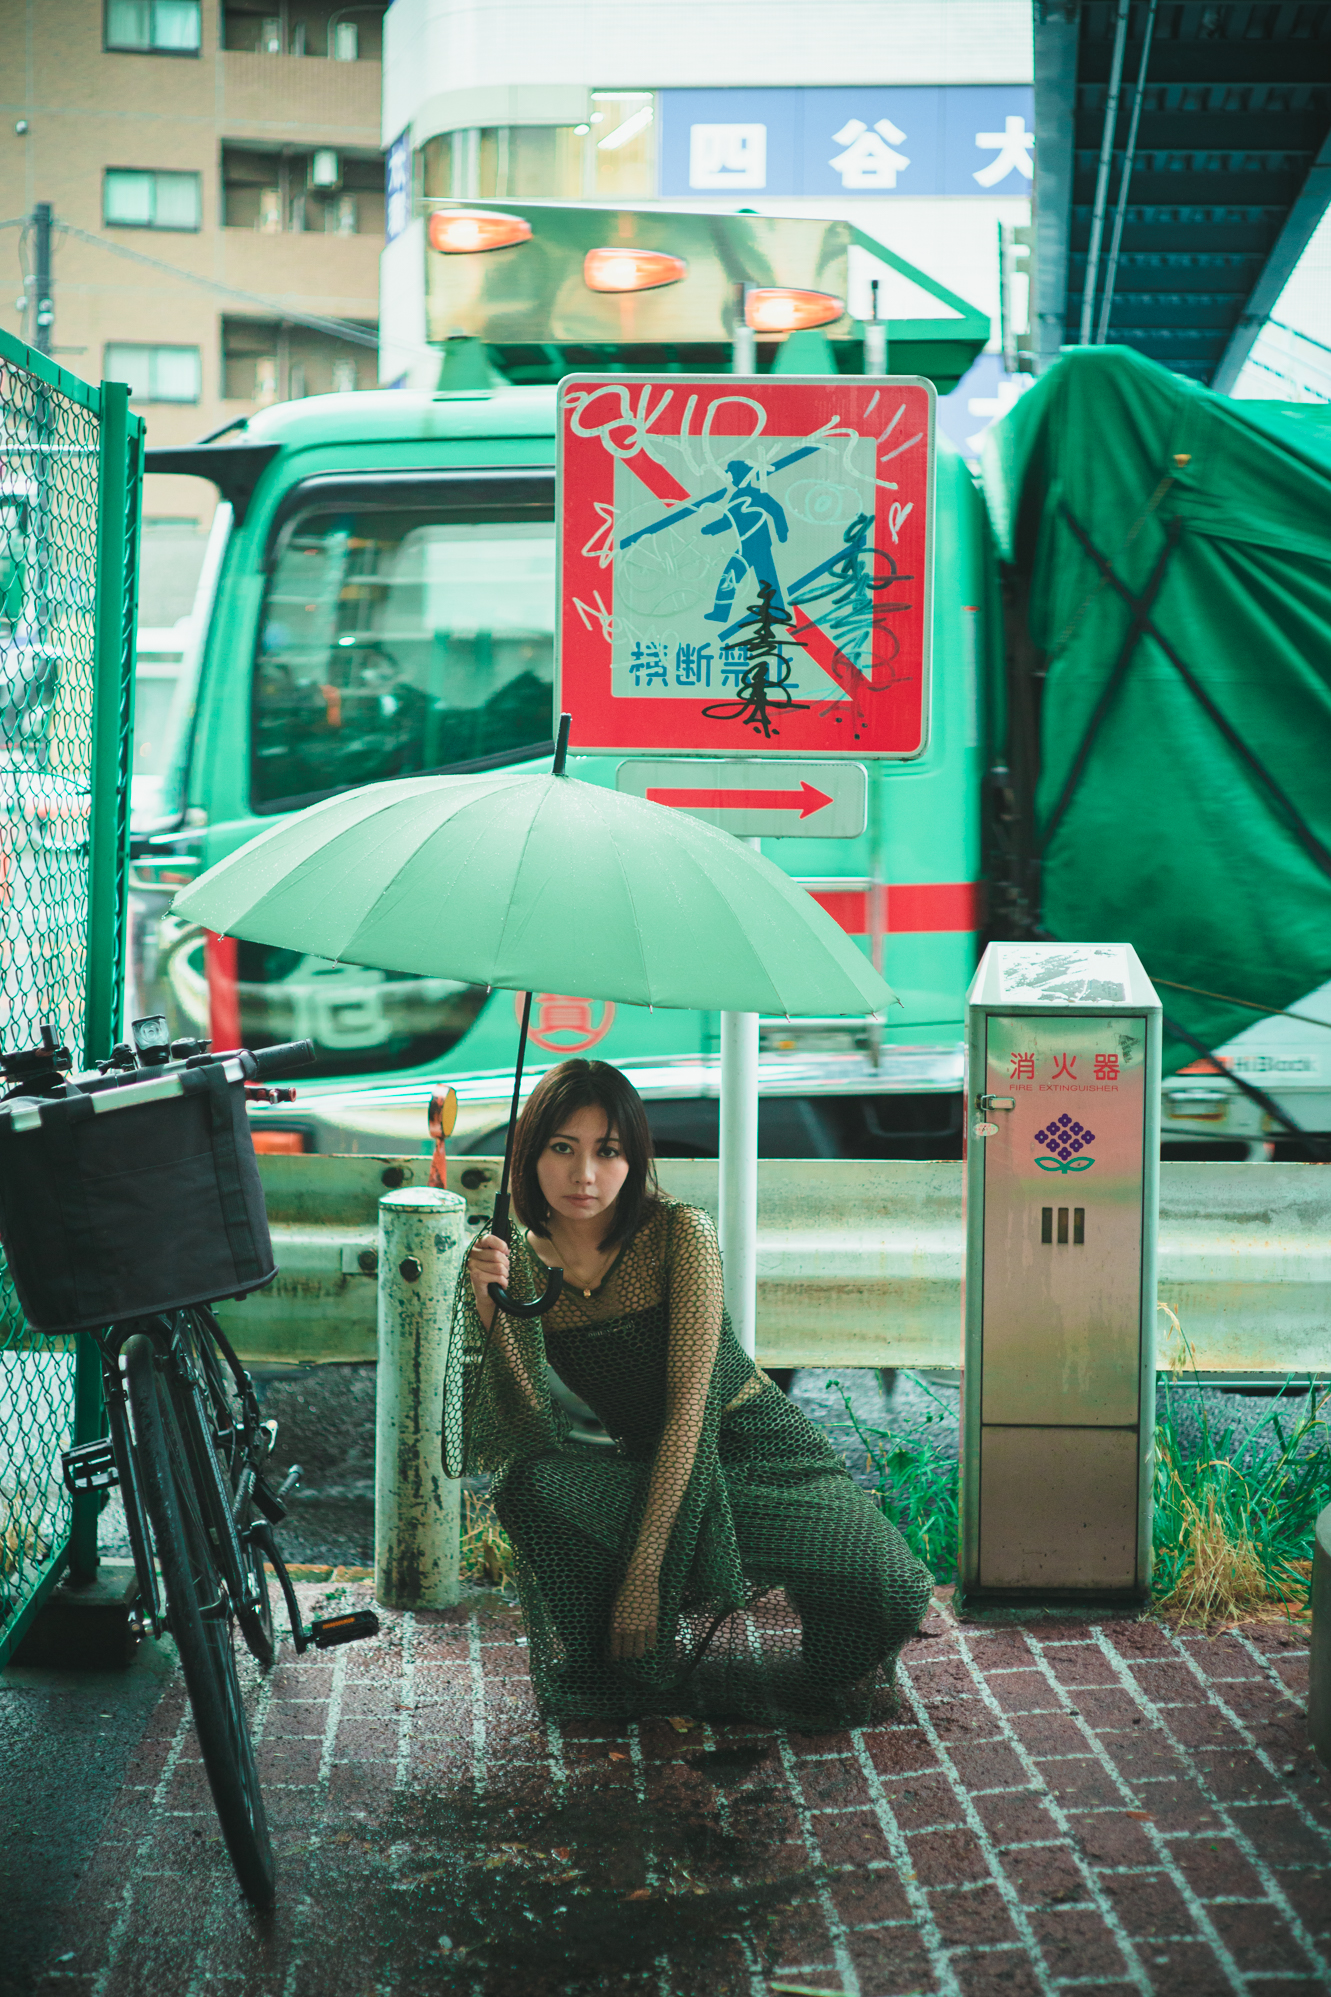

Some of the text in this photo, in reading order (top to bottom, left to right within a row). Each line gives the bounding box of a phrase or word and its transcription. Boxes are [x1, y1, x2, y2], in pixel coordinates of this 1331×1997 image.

[689, 116, 1034, 189] 四谷大
[1009, 1052, 1121, 1081] 消火器
[1009, 1084, 1119, 1093] FIRE EXTINGUISHER
